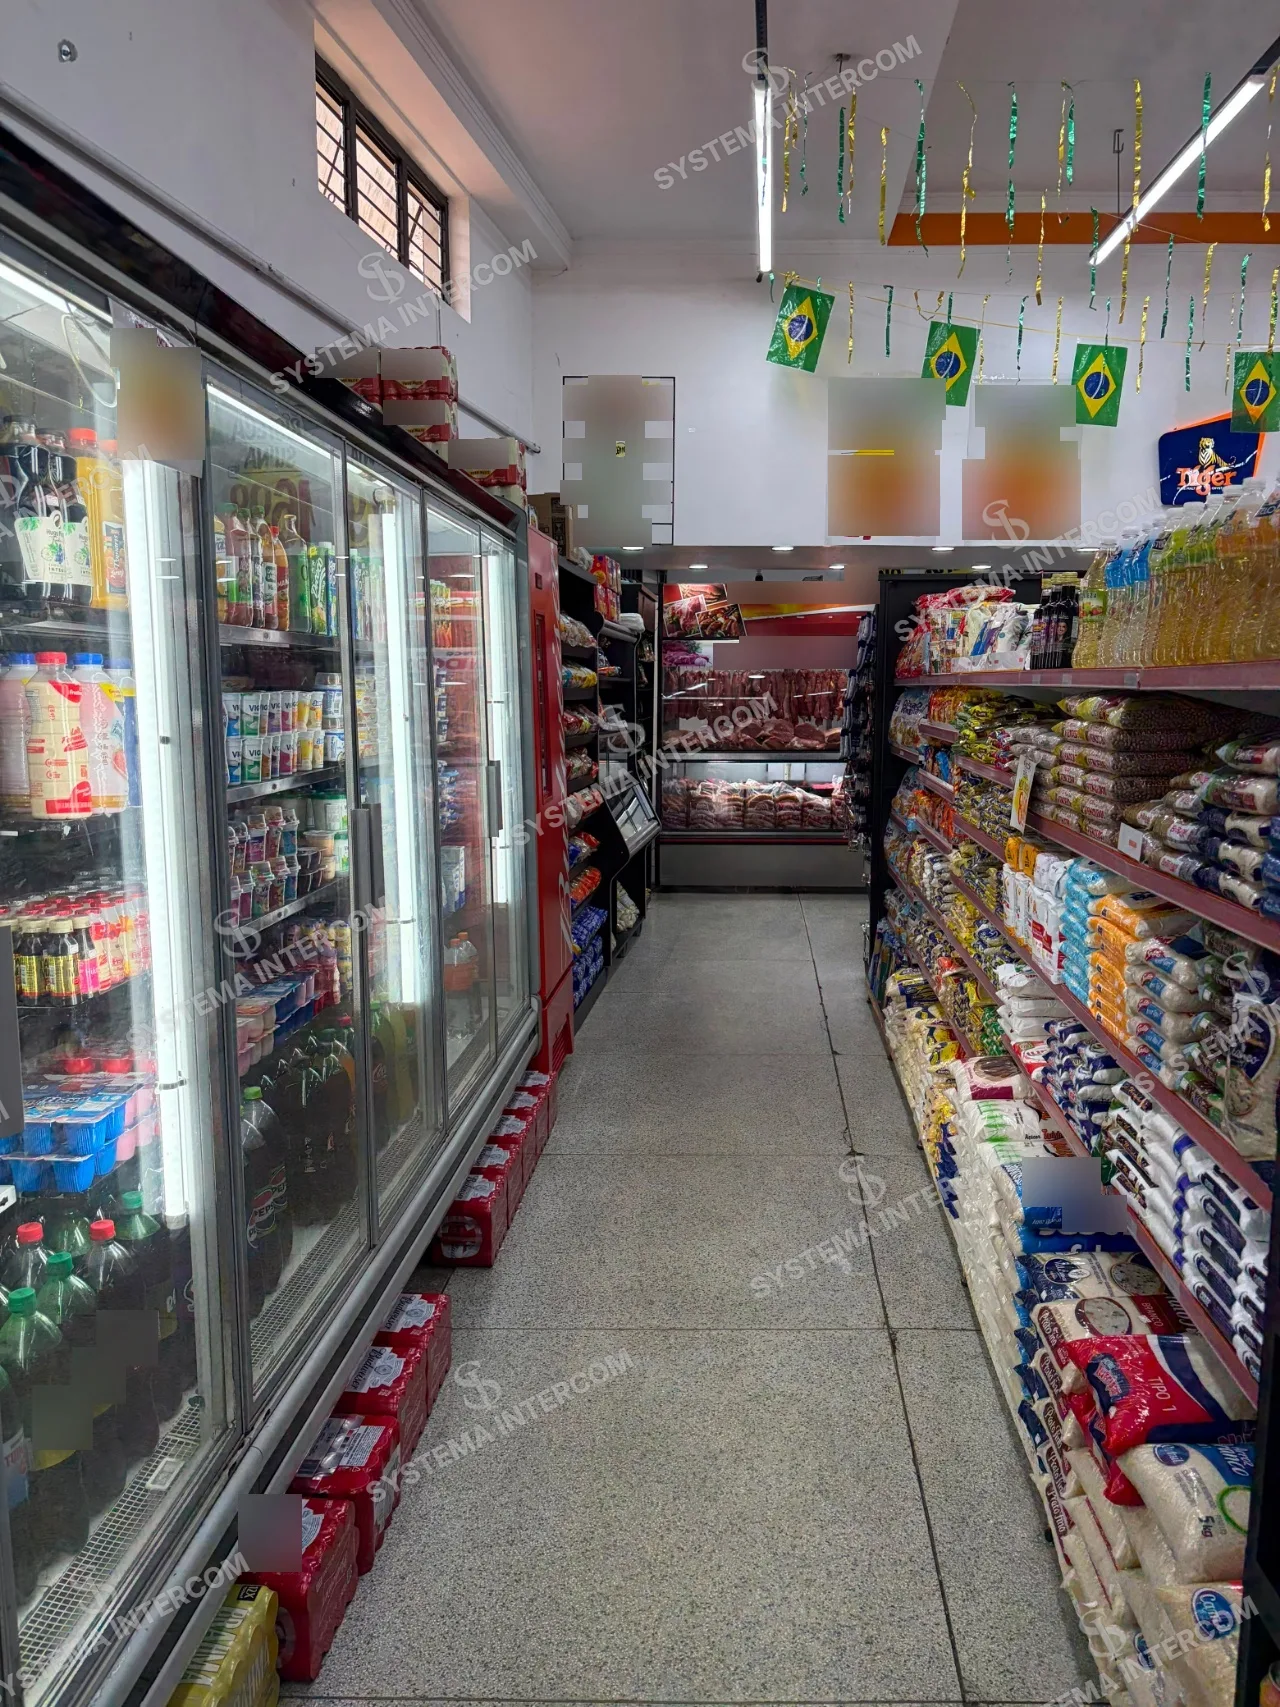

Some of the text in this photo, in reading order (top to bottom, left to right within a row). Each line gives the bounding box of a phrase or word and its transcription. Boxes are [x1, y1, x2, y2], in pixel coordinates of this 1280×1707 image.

[1177, 464, 1237, 496] Tiger
[385, 1295, 416, 1330] Budweiser
[1141, 1302, 1164, 1327] BRANCO
[351, 1347, 387, 1391] Budweiser
[1148, 1376, 1177, 1412] TIPO 1
[1047, 1488, 1060, 1515] Prato
[182, 1606, 249, 1686] BRAHMA
